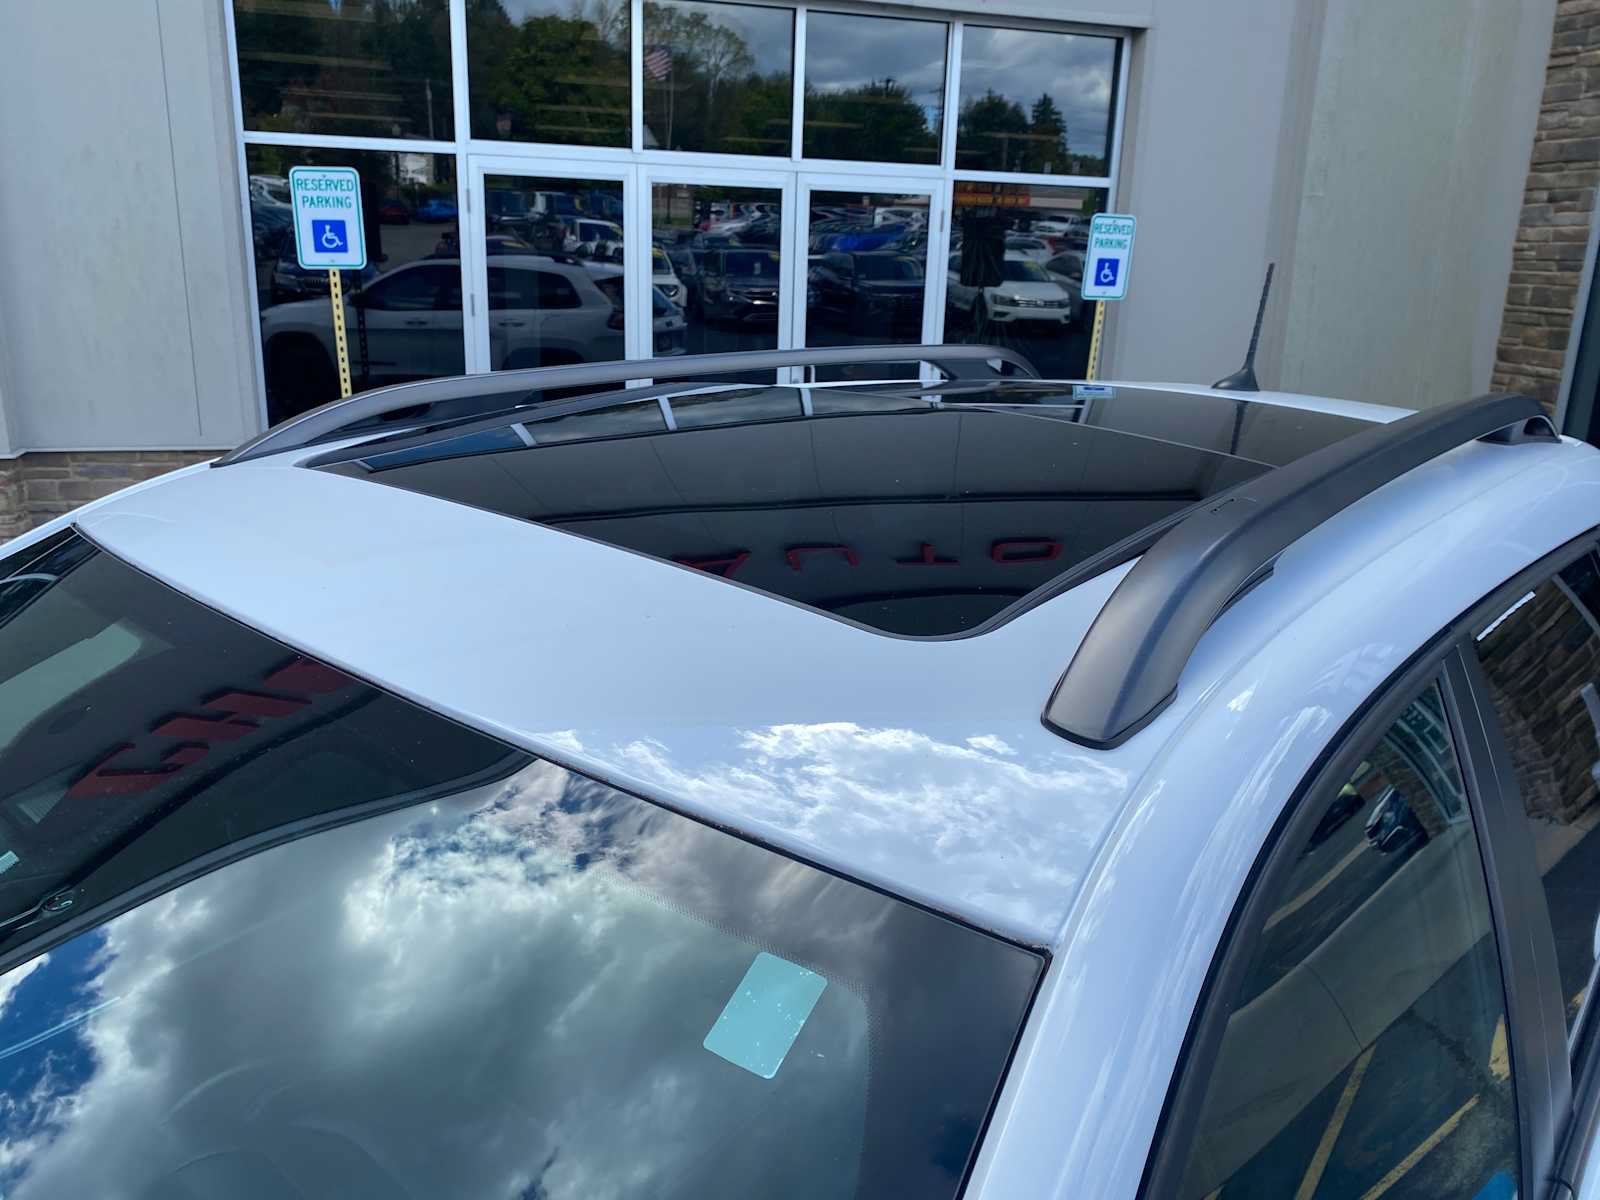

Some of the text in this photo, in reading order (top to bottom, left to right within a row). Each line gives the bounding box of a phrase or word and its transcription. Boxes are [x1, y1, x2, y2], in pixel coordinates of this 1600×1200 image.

[297, 178, 353, 191] RESERVED
[302, 196, 352, 208] PARKING
[1093, 223, 1131, 235] RESERVED
[1095, 238, 1128, 249] PARKING
